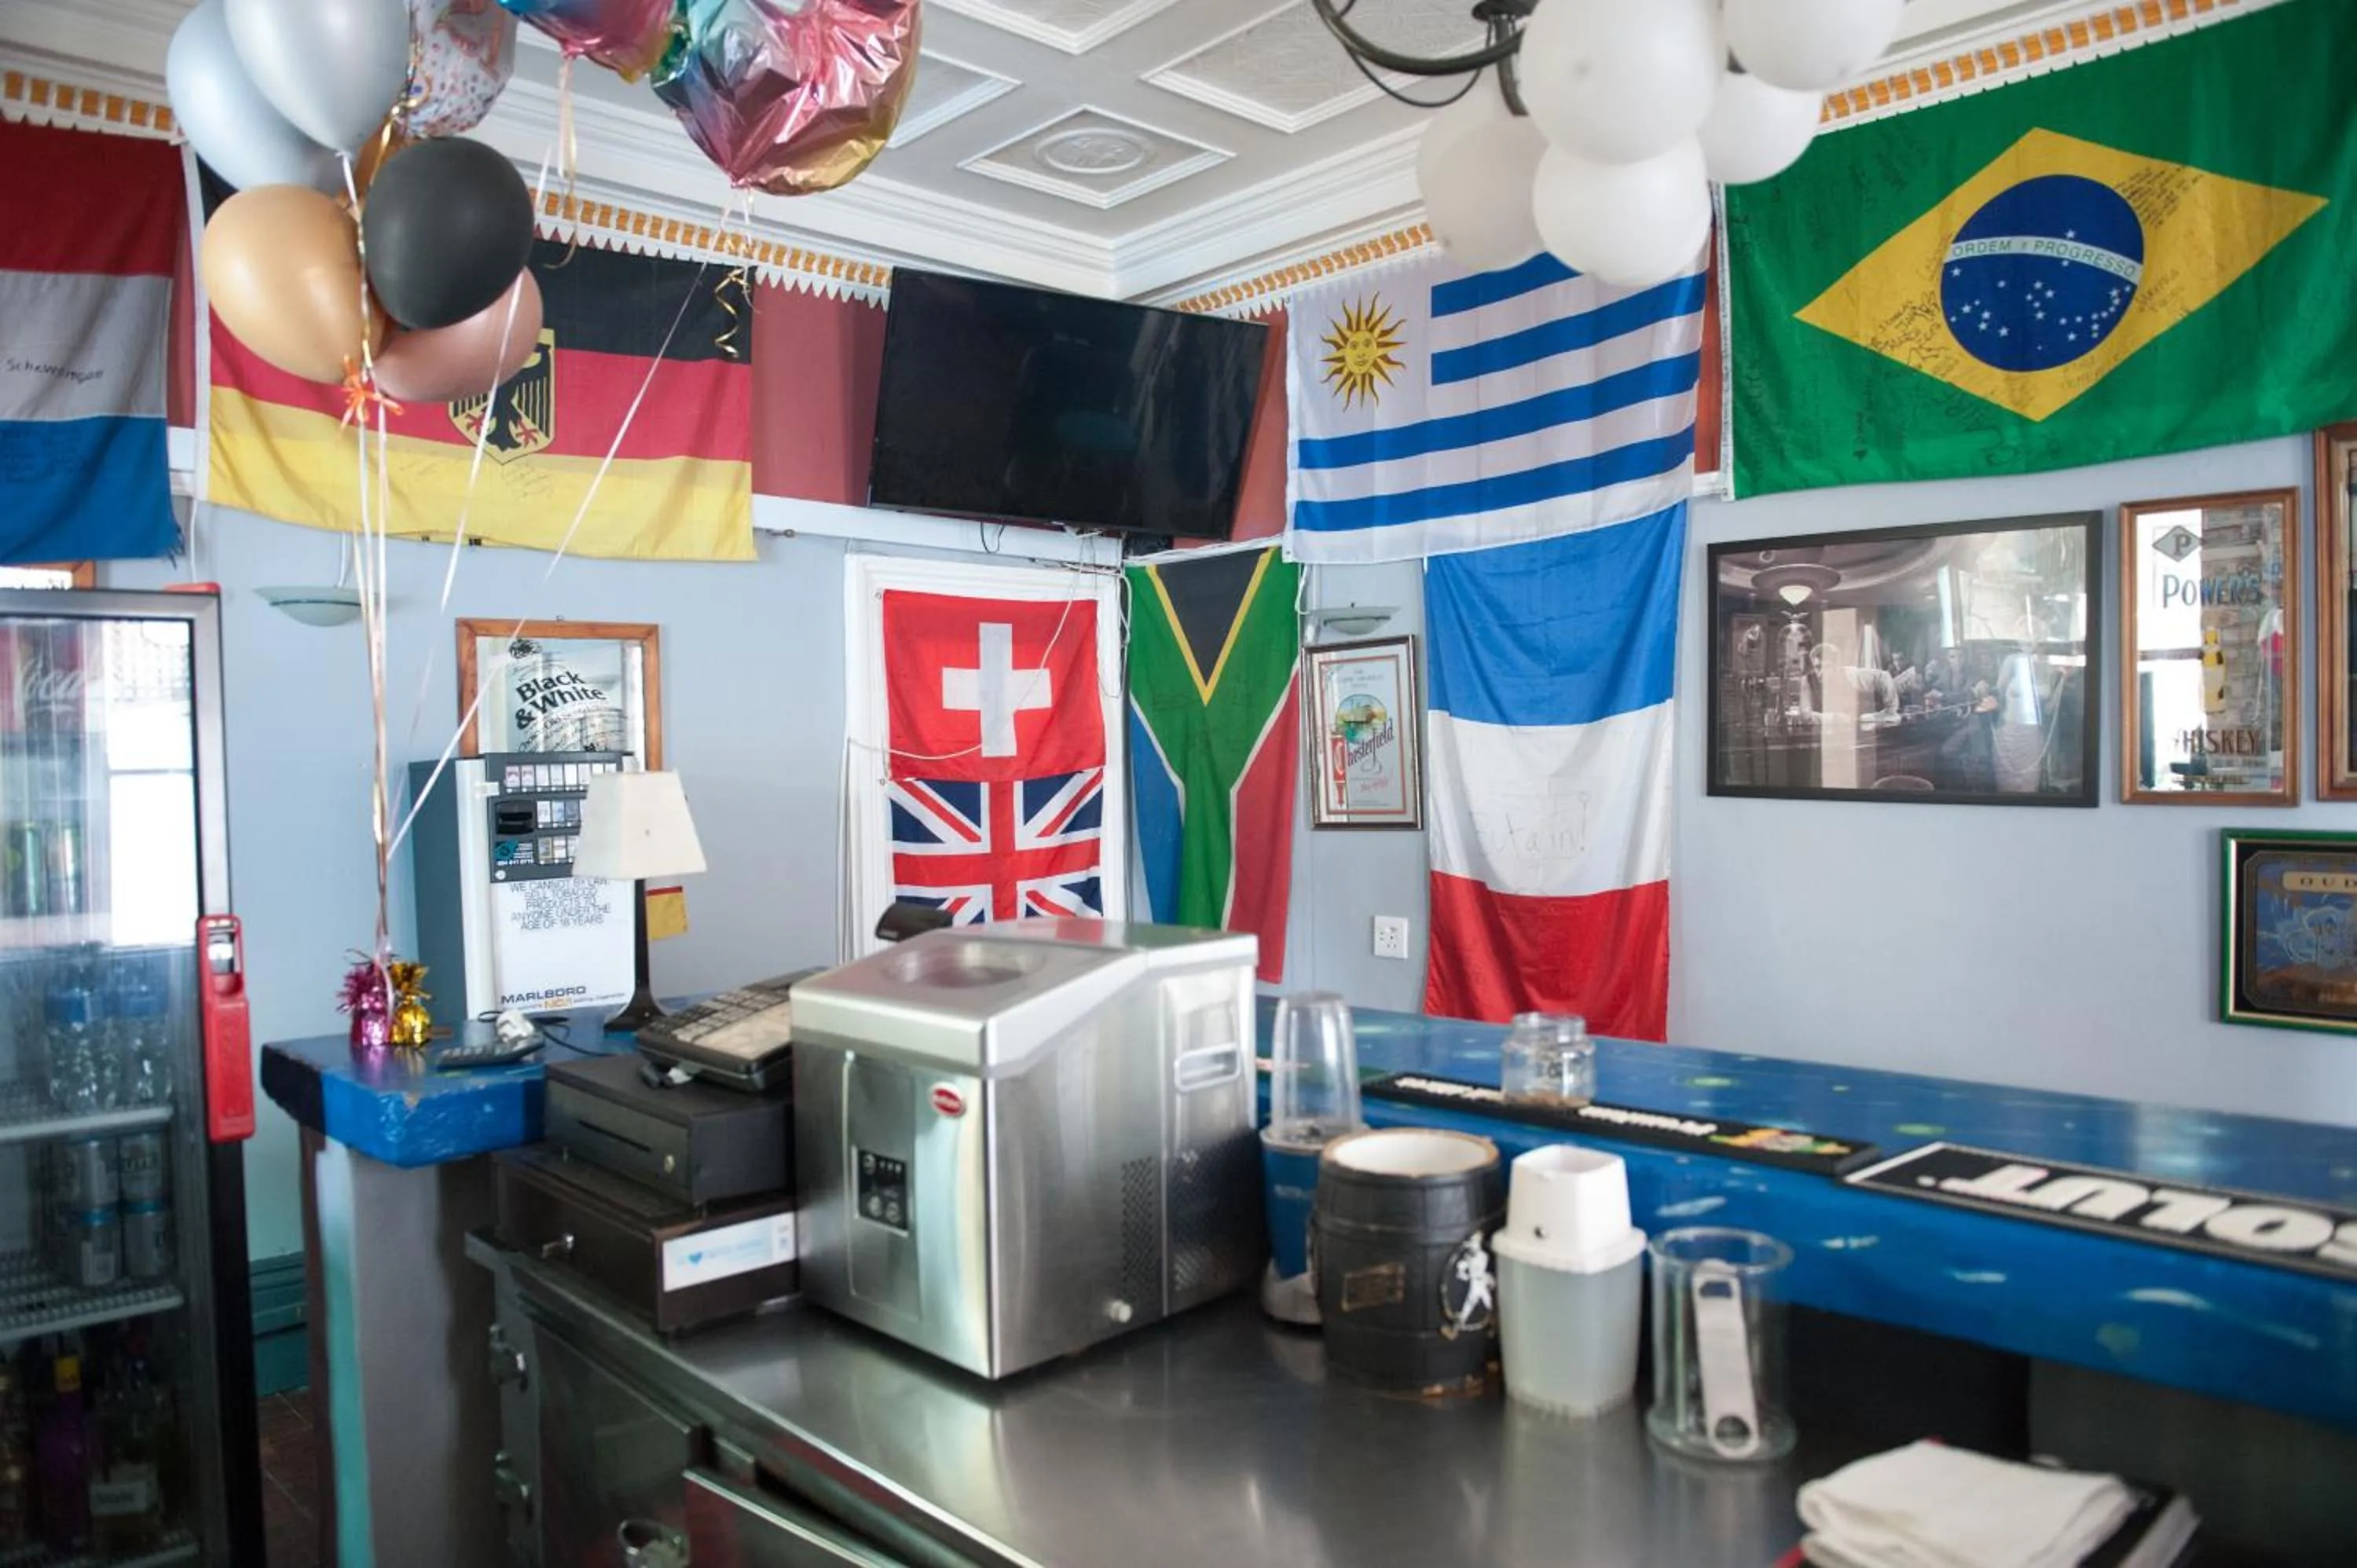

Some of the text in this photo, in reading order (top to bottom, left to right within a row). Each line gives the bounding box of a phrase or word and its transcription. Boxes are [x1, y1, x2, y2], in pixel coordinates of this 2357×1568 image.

[1952, 240, 2011, 257] ORDEM
[2034, 240, 2136, 277] PROGRESSO
[2173, 533, 2192, 555] P
[515, 670, 585, 704] Black
[515, 708, 537, 730] &
[529, 686, 607, 714] White
[2172, 728, 2261, 755] HISKEY
[510, 882, 526, 892] WE
[501, 986, 587, 1005] MARLBORO
